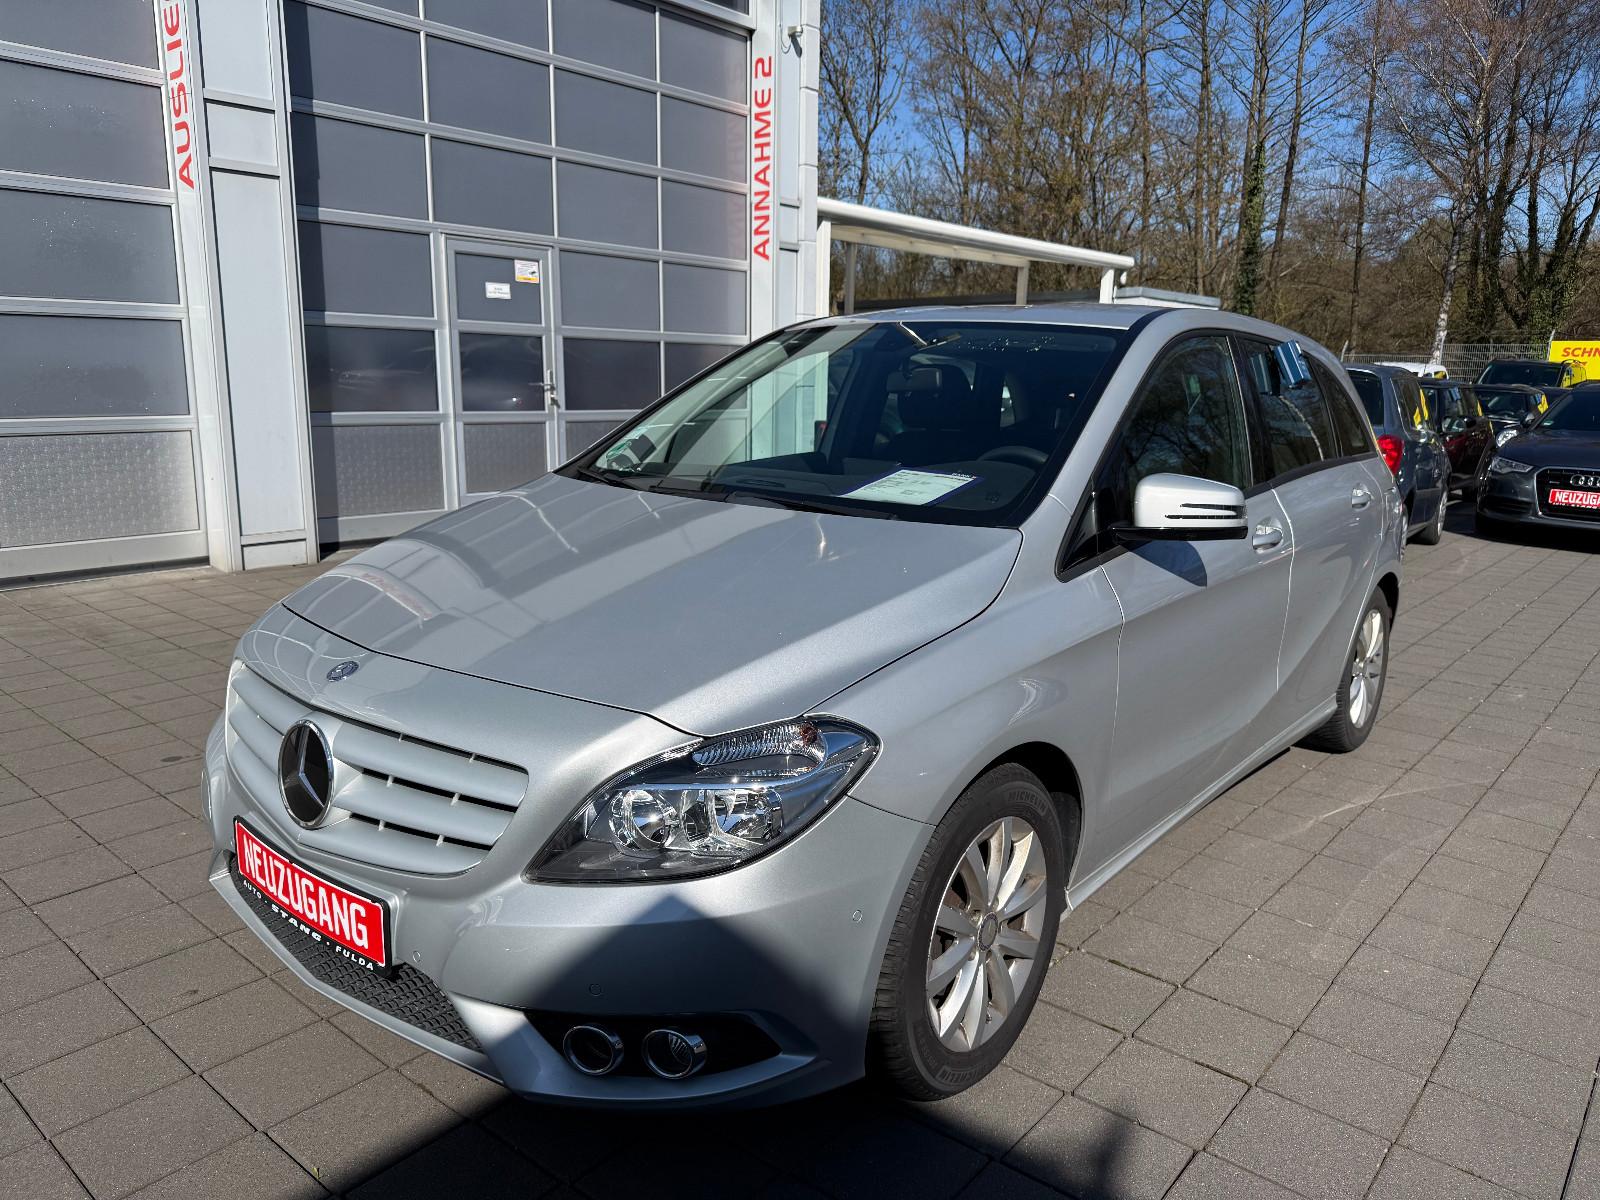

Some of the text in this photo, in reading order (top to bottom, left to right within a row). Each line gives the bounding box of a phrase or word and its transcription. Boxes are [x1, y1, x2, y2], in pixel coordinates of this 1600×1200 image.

[163, 0, 195, 190] AUSLIE
[753, 55, 772, 261] ANNAHME 2
[242, 833, 369, 949] NEUZUGANG
[243, 879, 374, 971] AUTO STANG FULDA
